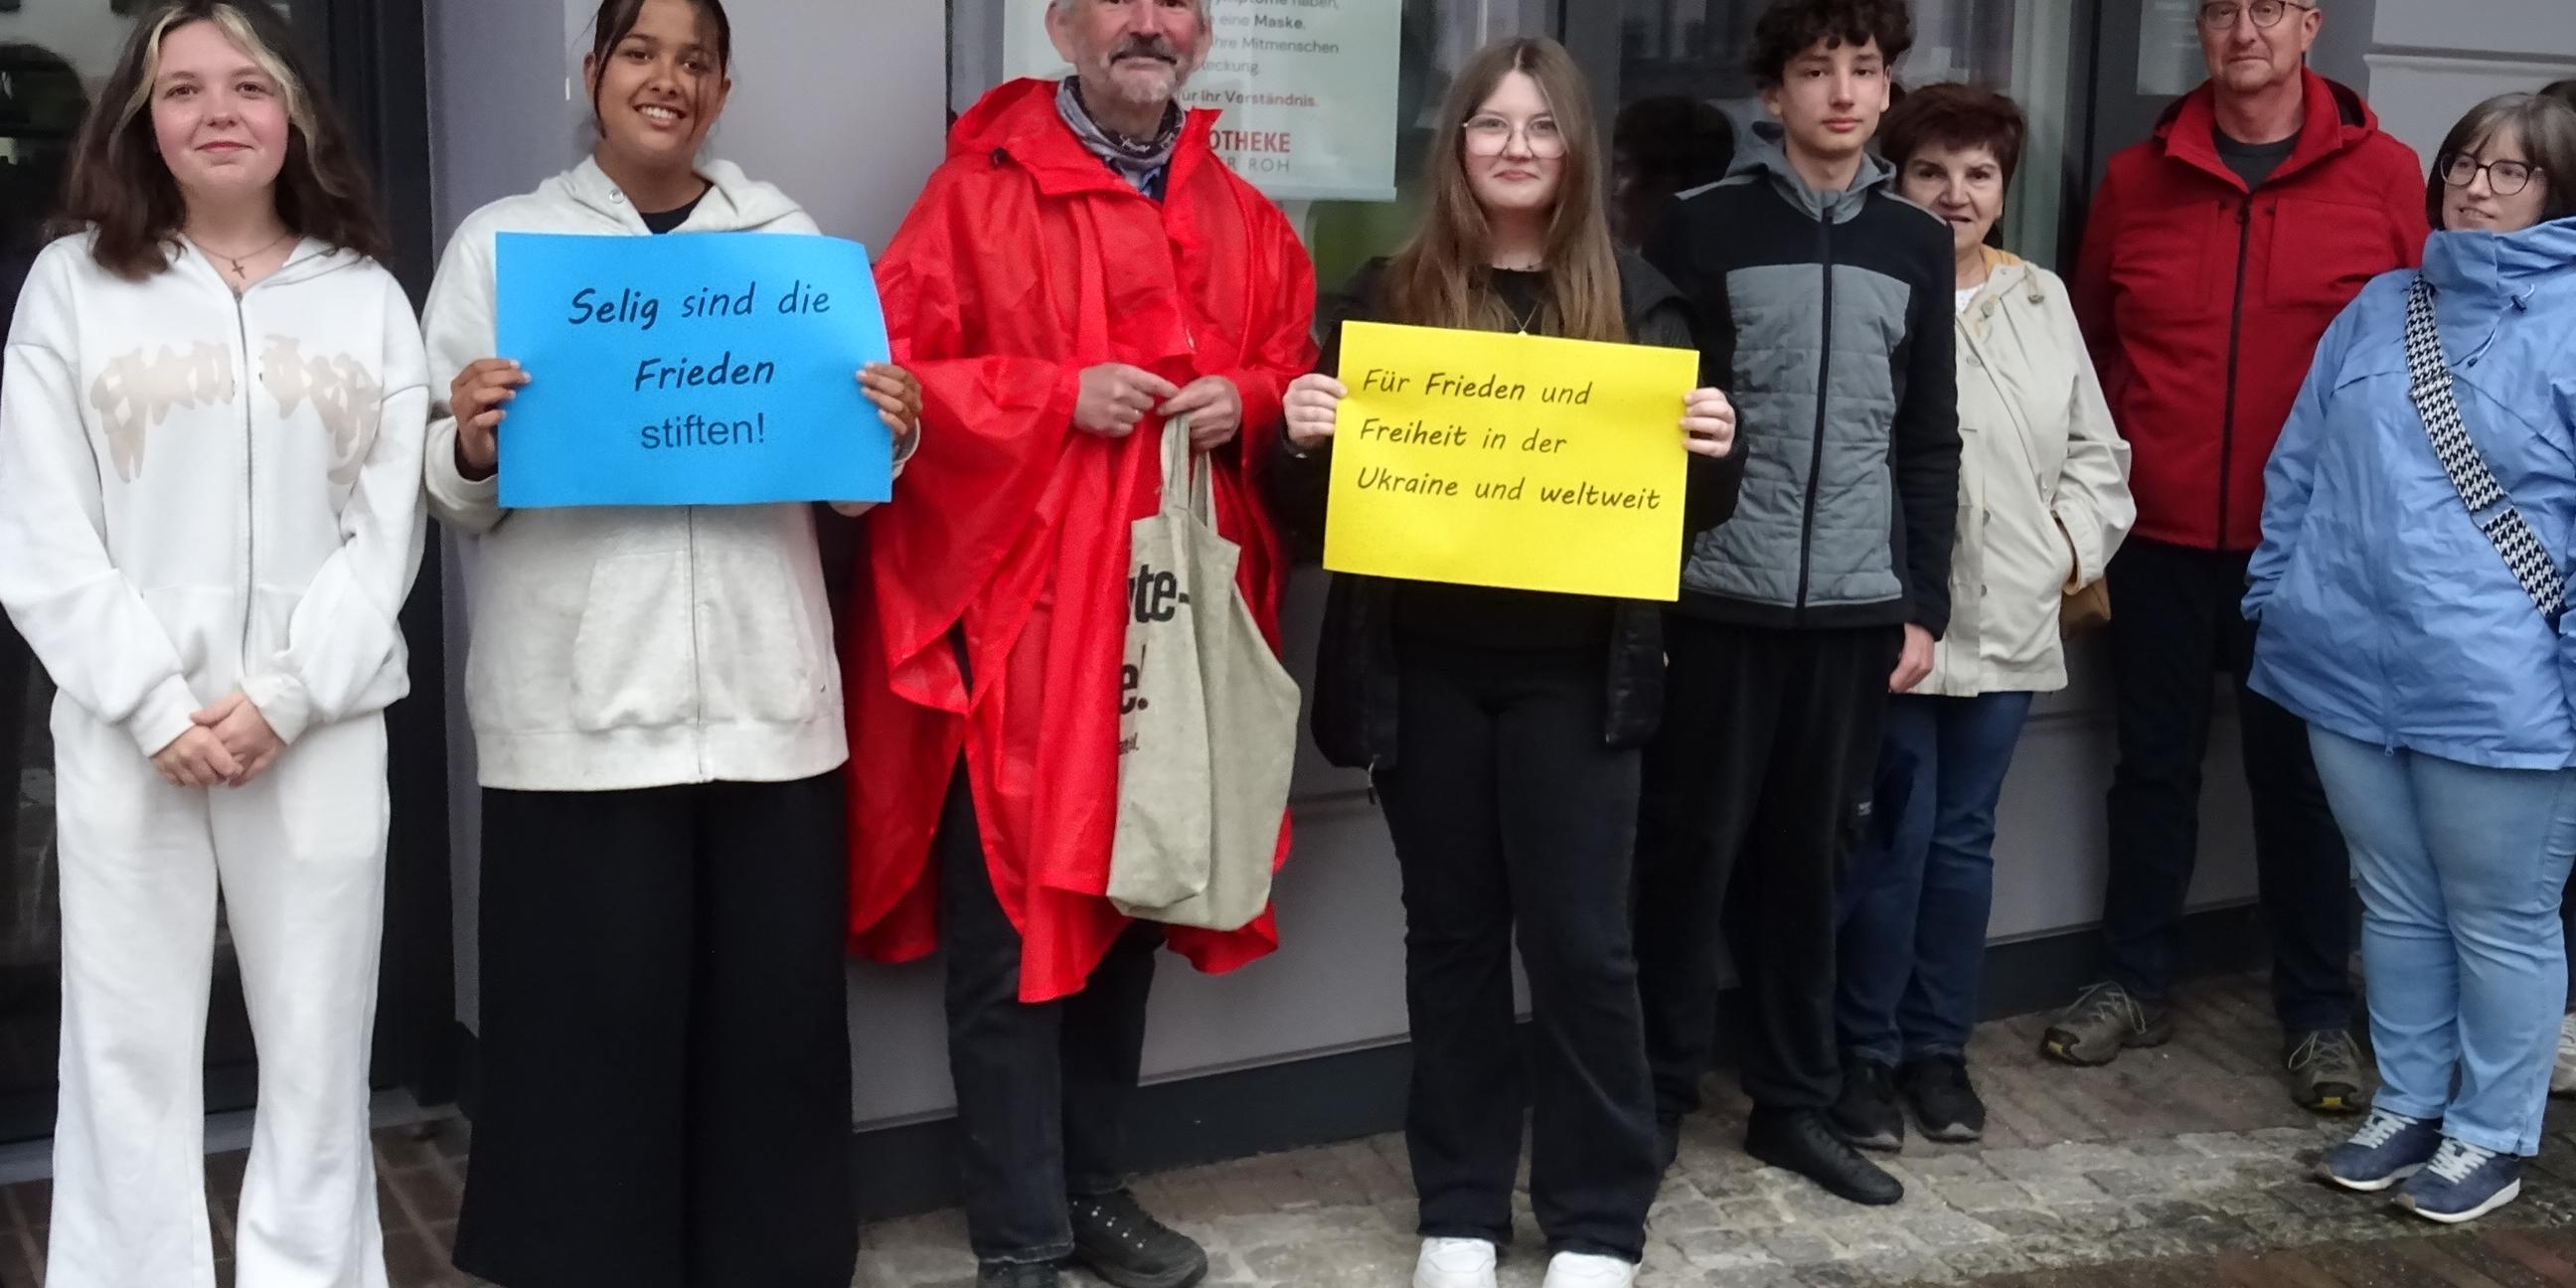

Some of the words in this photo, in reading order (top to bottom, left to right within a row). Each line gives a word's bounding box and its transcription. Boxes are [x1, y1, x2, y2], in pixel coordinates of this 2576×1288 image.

[1218, 14, 1250, 27] eine
[1254, 13, 1306, 30] Maske.
[1214, 34, 1238, 50] hre
[1241, 37, 1340, 54] Mitmenschen
[1201, 89, 1221, 101] Ihr
[1248, 157, 1290, 173] ROH
[567, 287, 659, 331] Selig
[681, 280, 756, 319] sind
[777, 278, 831, 315] die
[634, 350, 775, 393] Frieden
[1362, 368, 1411, 394] Für
[1424, 371, 1527, 402] Frieden
[1540, 381, 1594, 405] und
[640, 411, 764, 450] stiften!
[1359, 417, 1468, 447] Freiheit
[1481, 426, 1507, 450] in
[1521, 426, 1568, 454] der
[1357, 466, 1459, 497] Ukraine
[1474, 476, 1527, 502] und
[1539, 480, 1662, 511] weltweit
